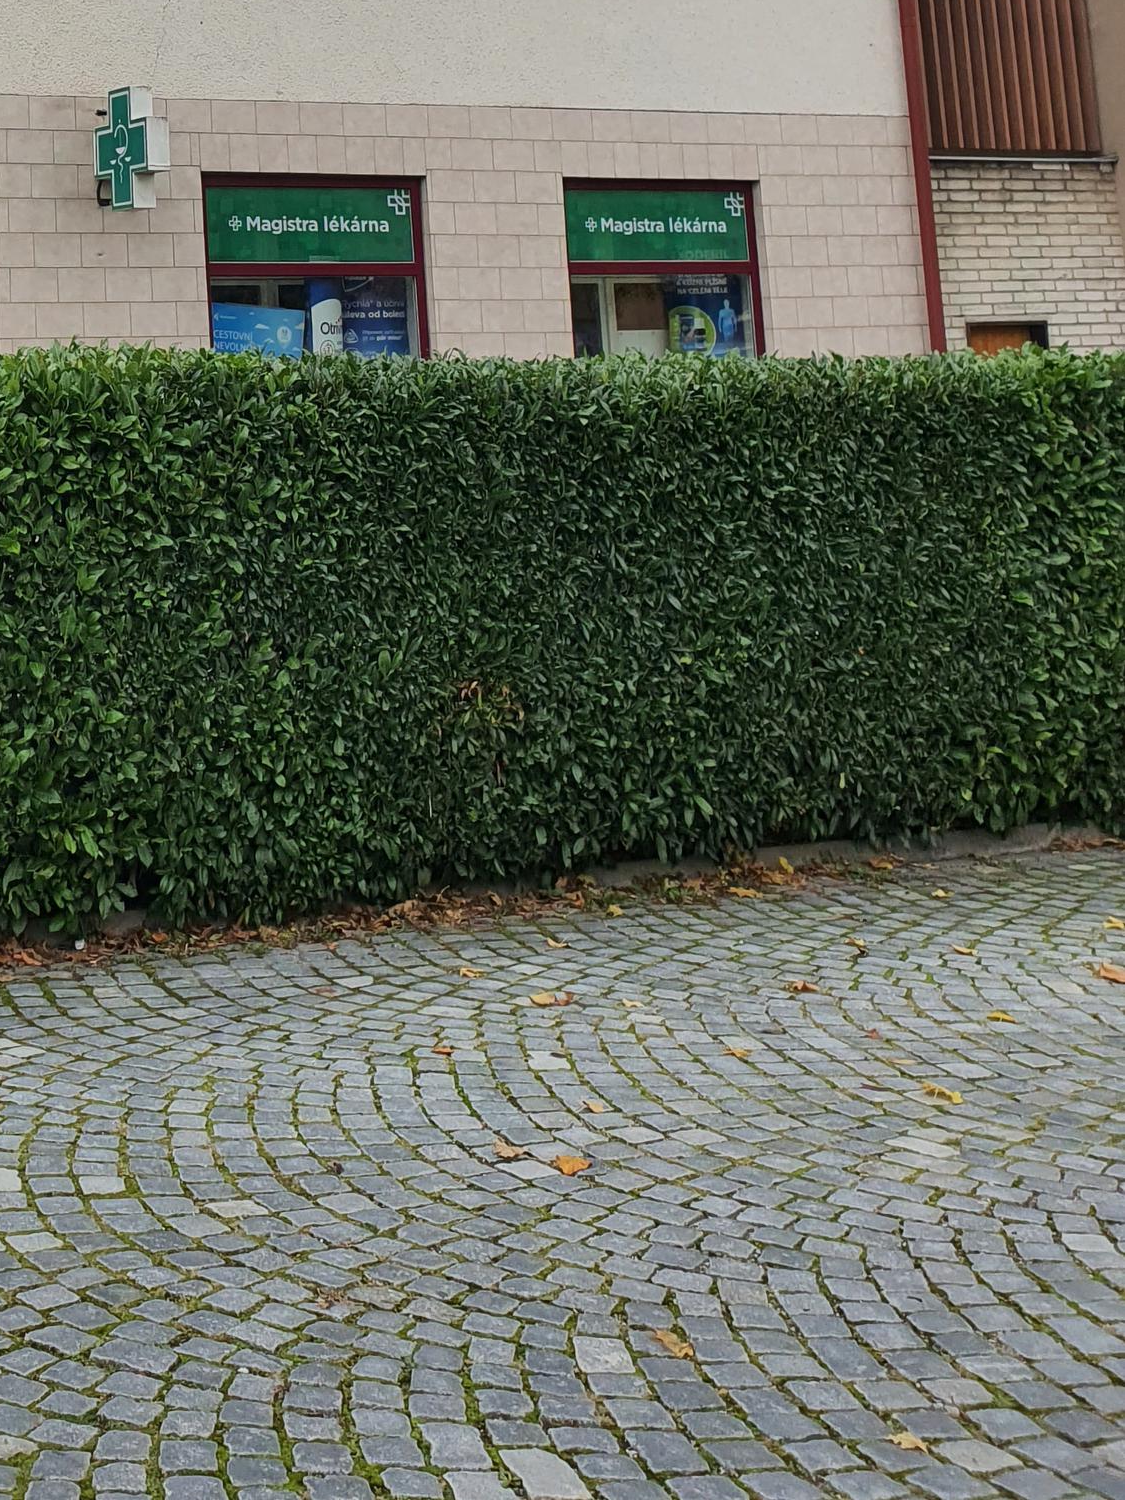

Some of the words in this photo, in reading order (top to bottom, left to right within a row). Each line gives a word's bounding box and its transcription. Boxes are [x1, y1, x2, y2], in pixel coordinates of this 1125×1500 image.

[246, 215, 319, 235] Magistra
[324, 215, 390, 233] lékárna
[600, 217, 665, 235] Magistra
[669, 216, 727, 233] lékárna
[368, 310, 381, 319] od
